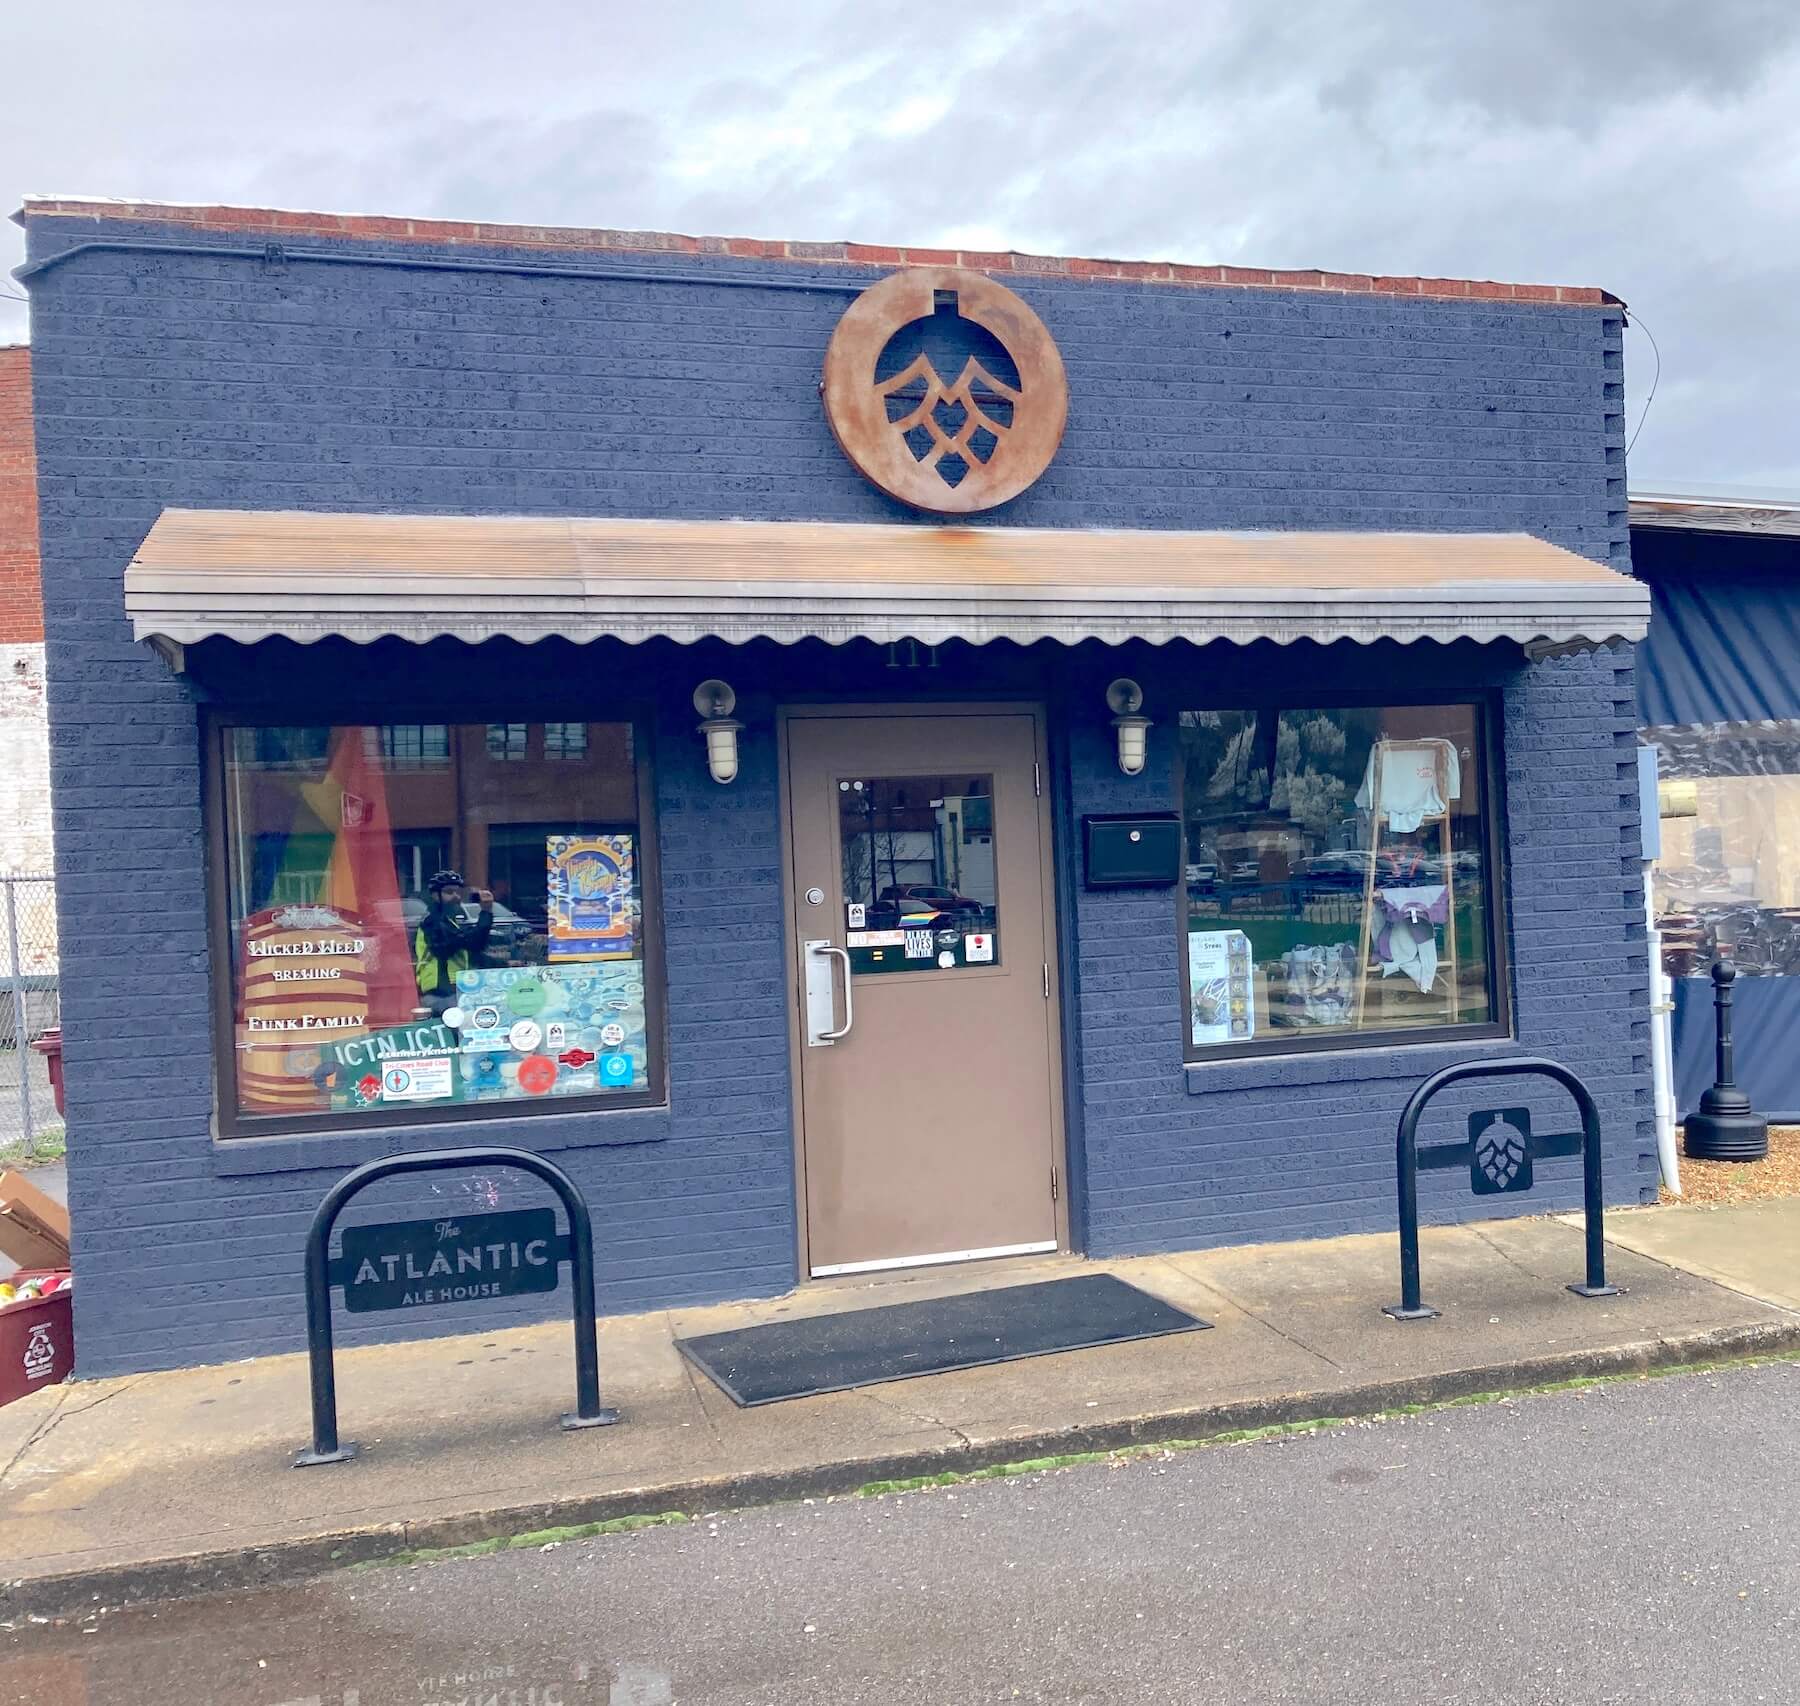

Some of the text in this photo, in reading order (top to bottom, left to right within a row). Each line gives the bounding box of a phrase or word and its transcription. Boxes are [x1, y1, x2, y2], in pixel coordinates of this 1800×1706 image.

[247, 938, 365, 956] WICKED WEED
[906, 938, 931, 949] LIVES
[272, 967, 341, 981] BREWING
[248, 1014, 365, 1031] FUNK FAMILY
[434, 1221, 461, 1242] The
[353, 1239, 549, 1286] ATLANTIC
[402, 1283, 502, 1305] ALE HOUSE
